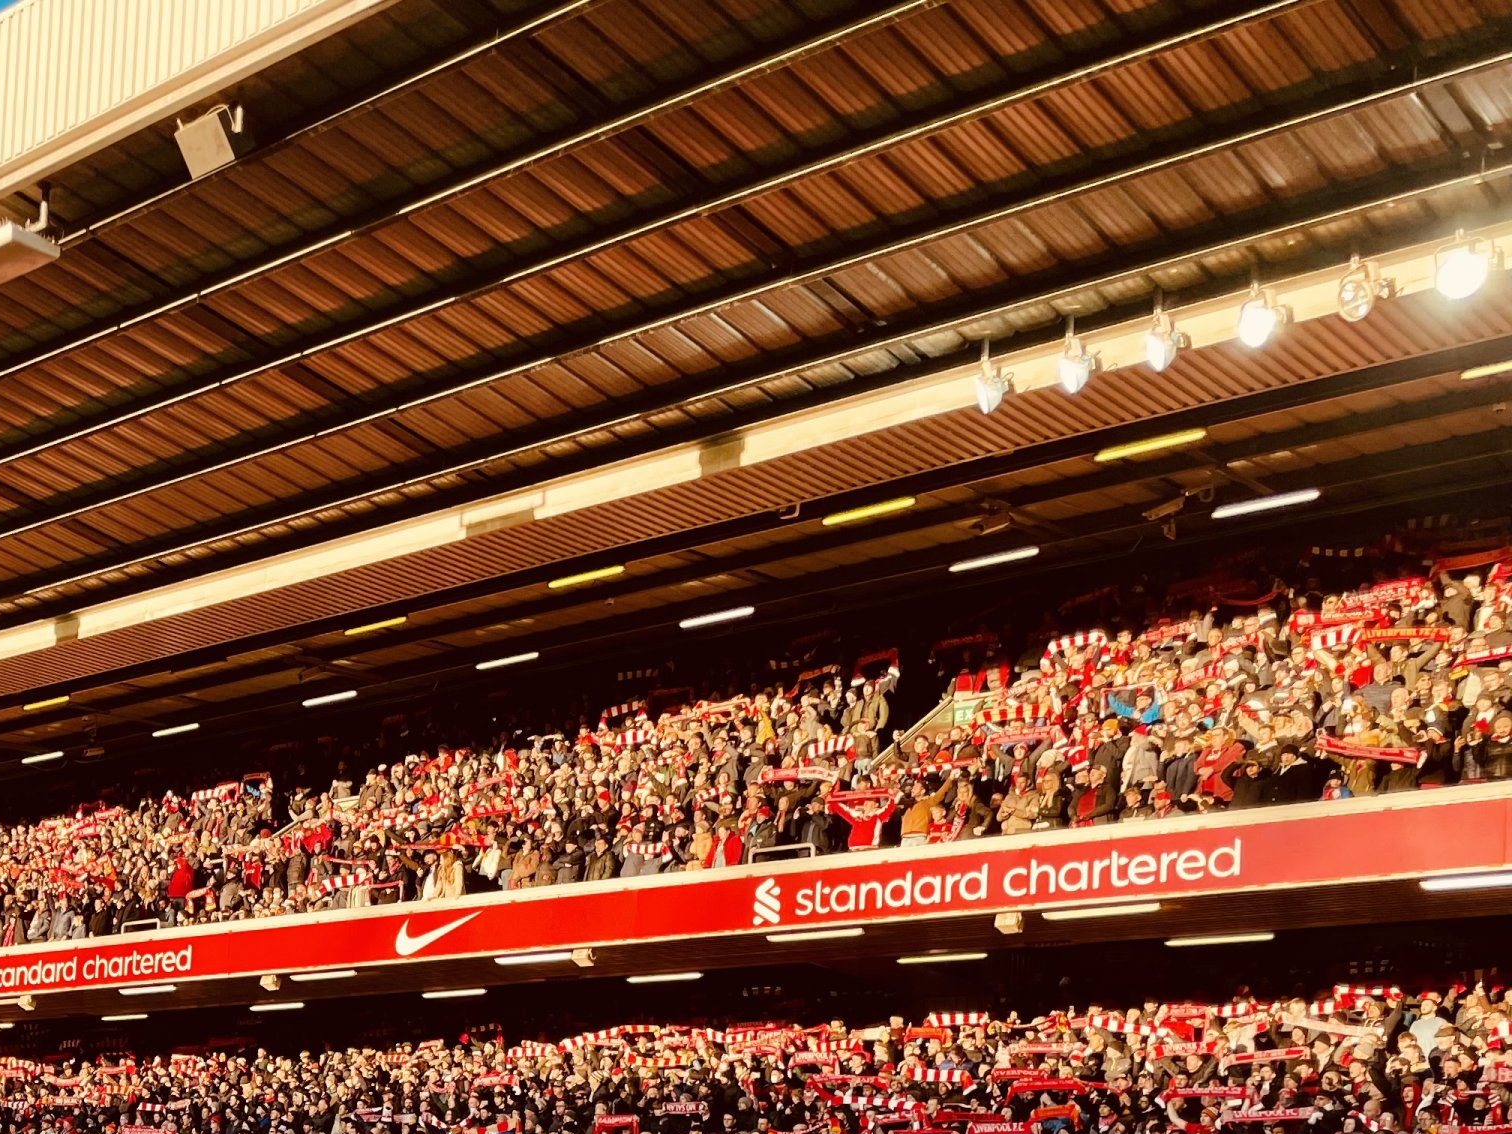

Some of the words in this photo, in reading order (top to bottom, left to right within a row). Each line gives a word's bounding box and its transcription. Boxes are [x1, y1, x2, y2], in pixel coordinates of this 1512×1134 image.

[955, 710, 973, 720] EX
[795, 863, 989, 917] standard
[1002, 838, 1242, 897] chartered
[82, 944, 193, 980] chartered
[972, 1122, 1011, 1133] LIVERPOOL
